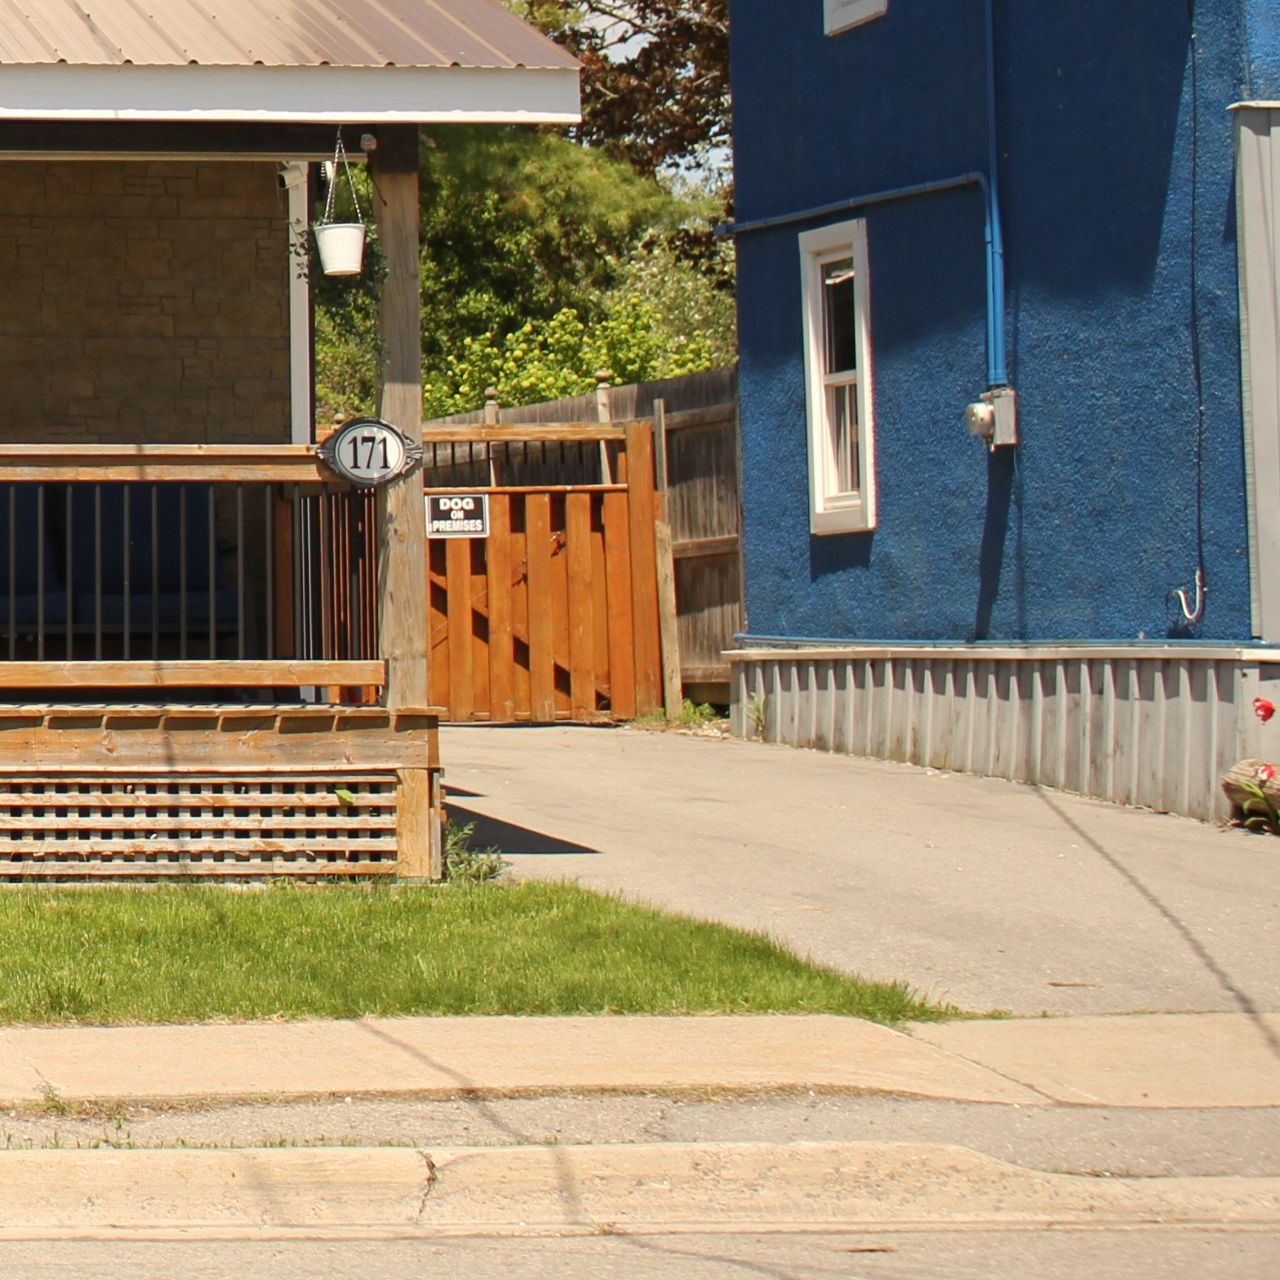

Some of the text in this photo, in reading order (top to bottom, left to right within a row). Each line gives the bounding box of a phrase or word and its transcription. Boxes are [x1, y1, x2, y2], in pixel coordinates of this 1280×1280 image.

[348, 436, 390, 469] 171
[439, 497, 475, 510] DOG
[450, 510, 464, 520] ON
[432, 519, 483, 532] PREMISES
